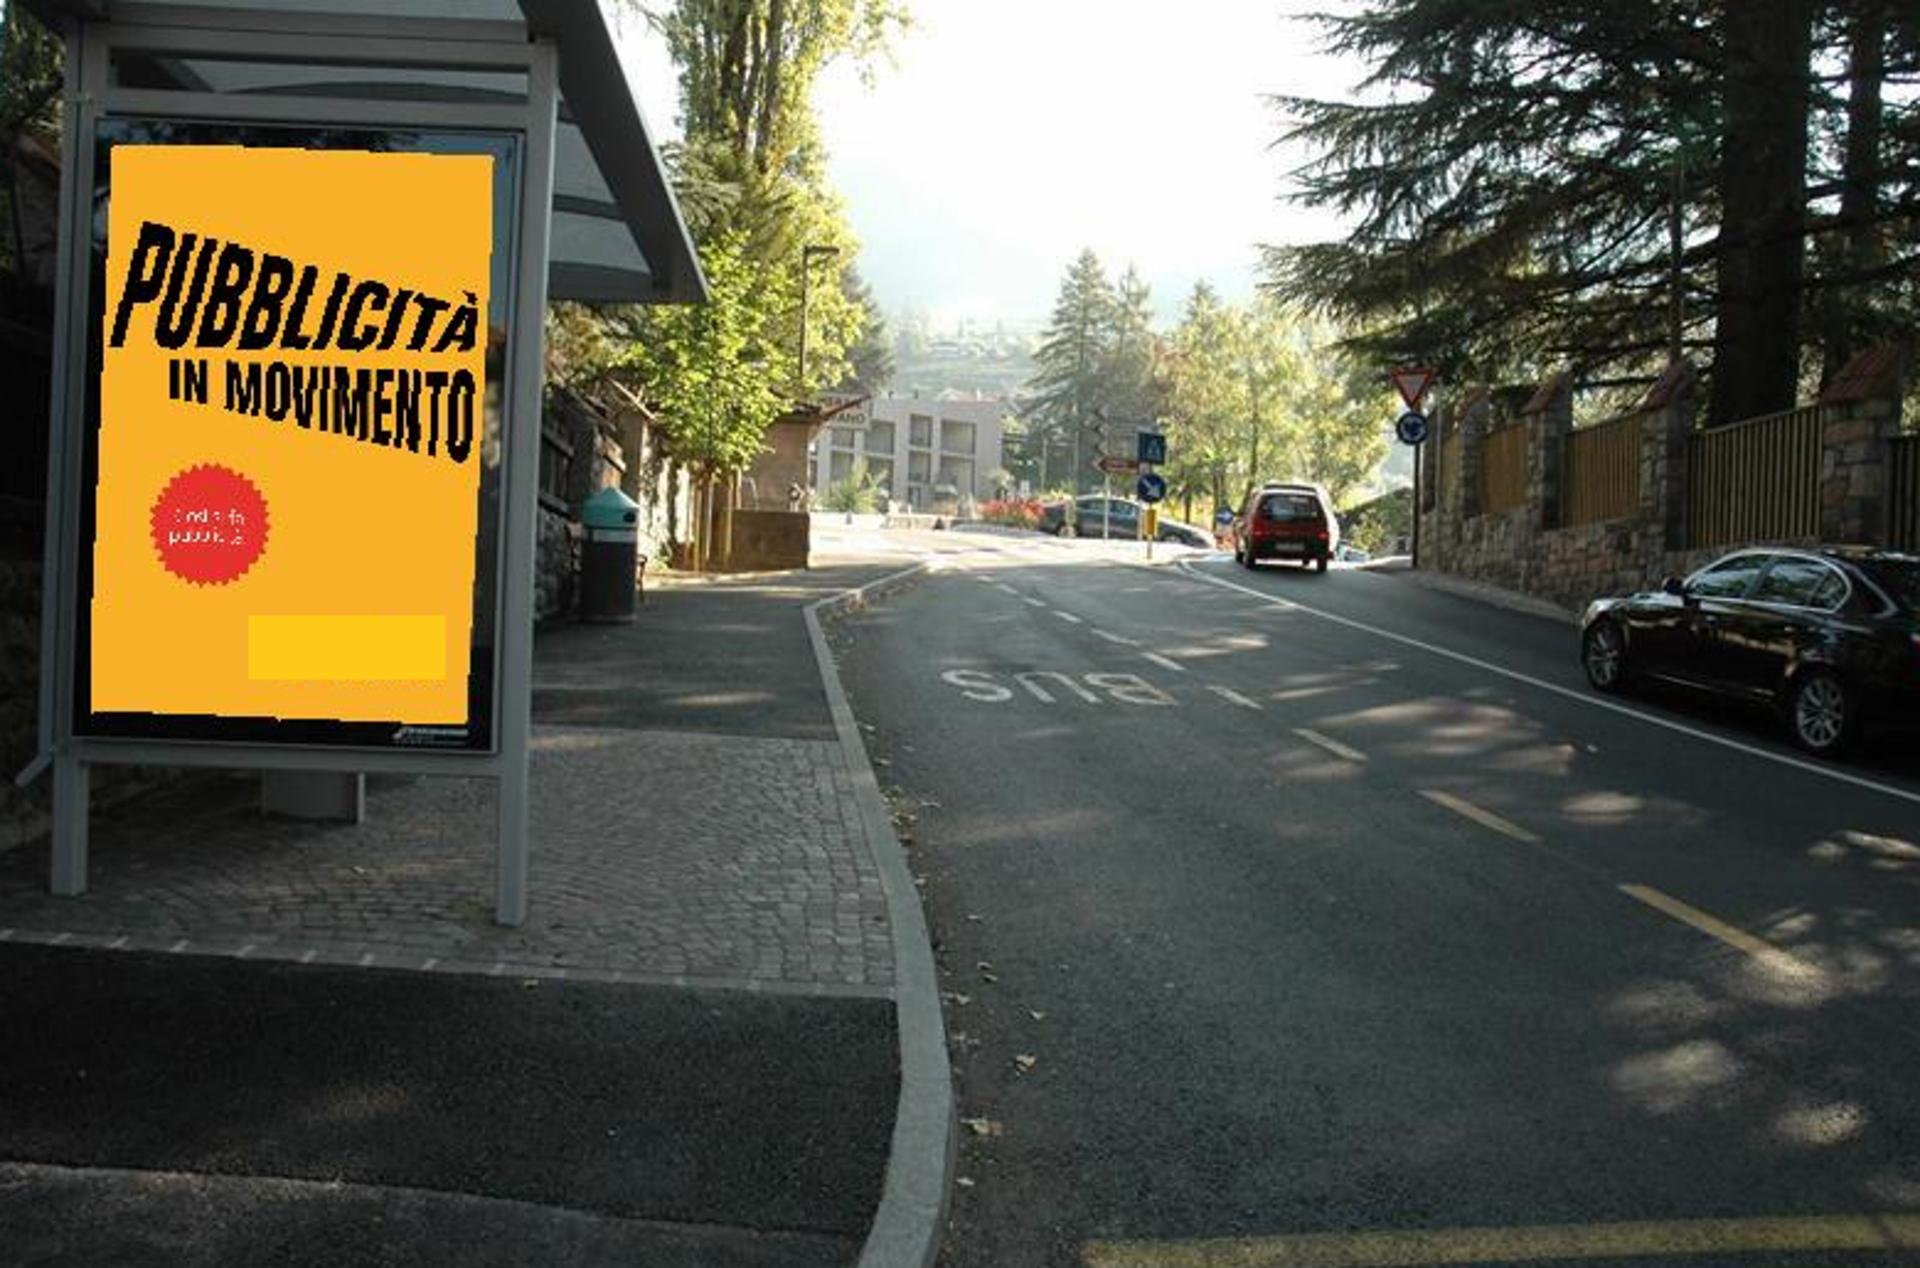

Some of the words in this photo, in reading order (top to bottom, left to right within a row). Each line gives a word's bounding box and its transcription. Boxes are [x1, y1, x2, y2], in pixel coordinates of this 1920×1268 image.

[109, 221, 479, 352] PUBBLICITÀ
[169, 359, 208, 405] IN
[224, 359, 477, 464] MOVIMENTO
[940, 668, 1180, 706] BUS
